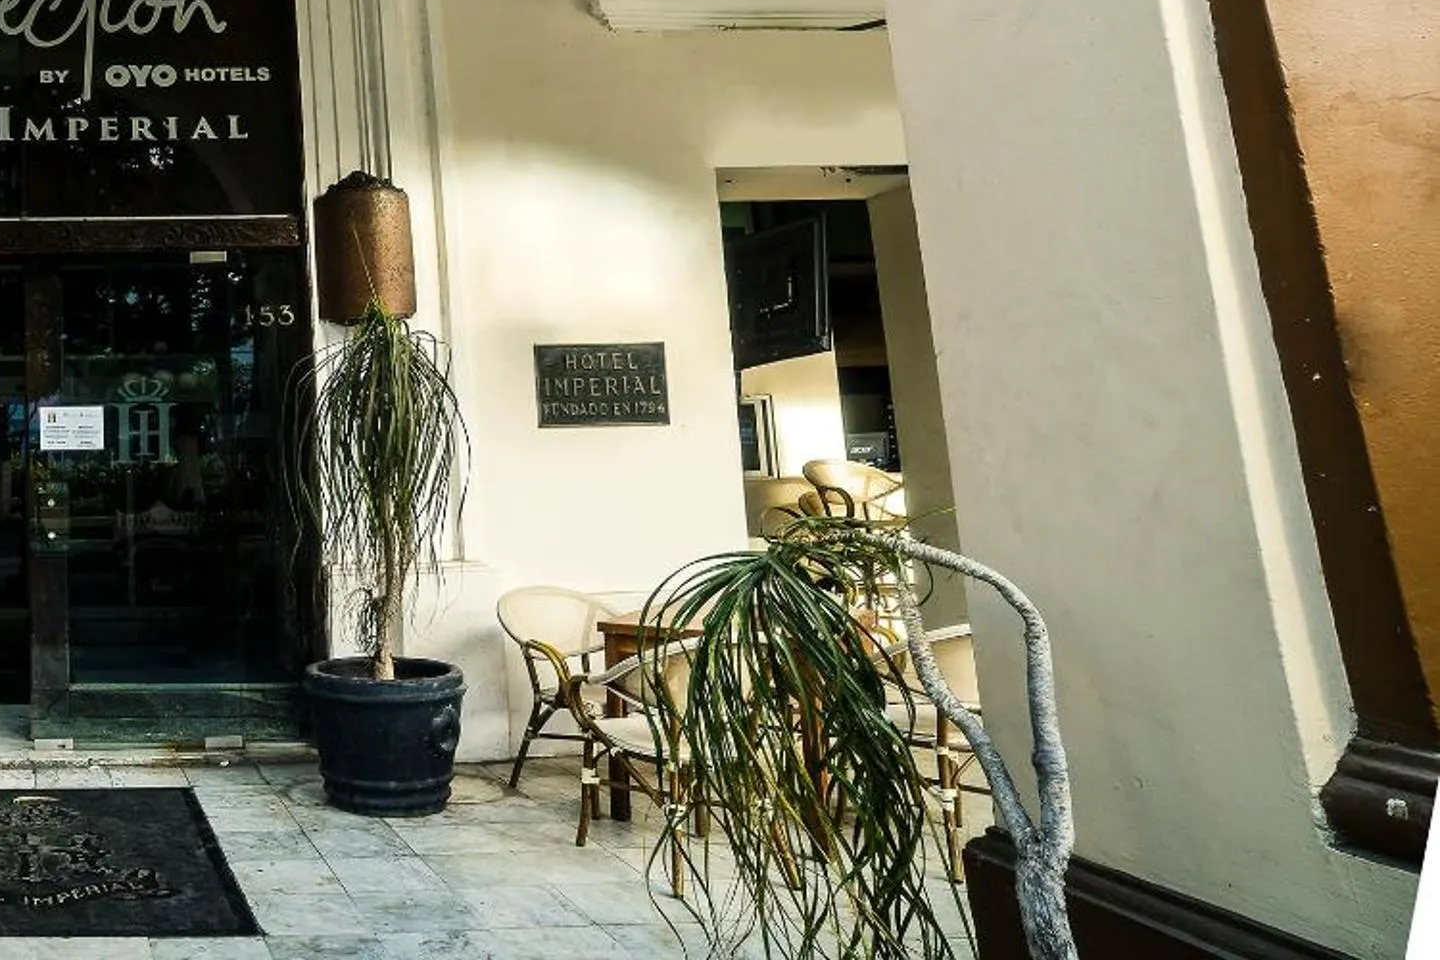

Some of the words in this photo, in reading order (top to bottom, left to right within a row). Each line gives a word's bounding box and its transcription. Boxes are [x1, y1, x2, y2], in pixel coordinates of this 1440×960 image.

[39, 70, 69, 84] BY
[104, 64, 178, 88] OYO
[184, 66, 271, 83] HOTELS
[244, 303, 295, 328] 153
[564, 352, 638, 371] HOTEL
[543, 375, 661, 397] IMPERIAL
[613, 401, 631, 416] EN
